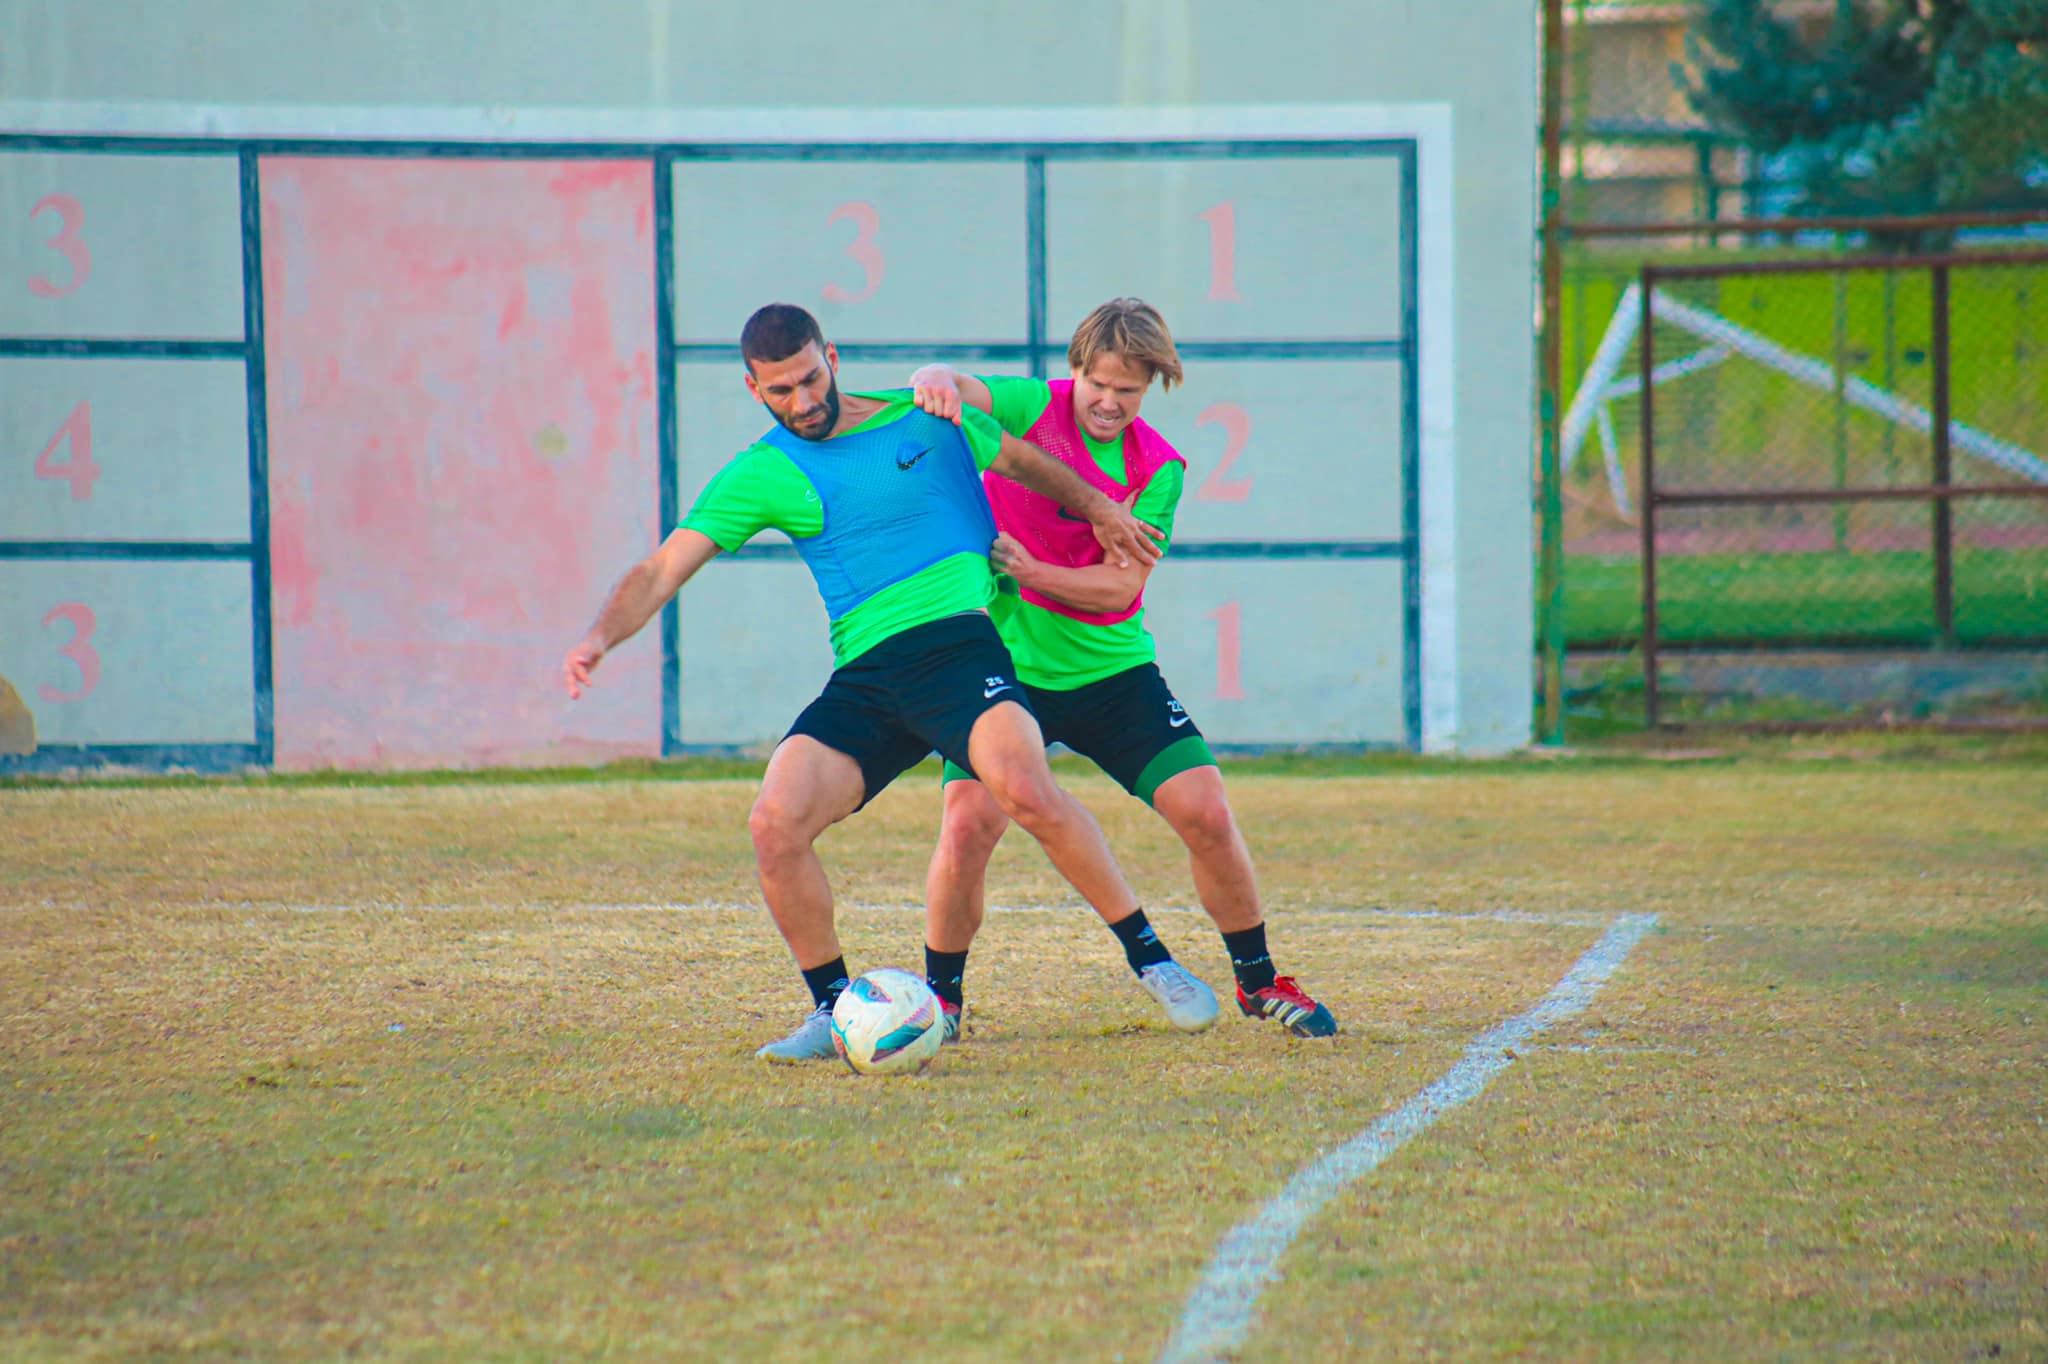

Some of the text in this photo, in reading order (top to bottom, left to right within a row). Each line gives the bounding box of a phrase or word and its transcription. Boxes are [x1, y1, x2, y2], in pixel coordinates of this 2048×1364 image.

[28, 193, 92, 298] 3
[822, 201, 885, 303] 3
[1200, 200, 1241, 301] 1
[34, 401, 101, 500] 4
[1196, 403, 1253, 502] 2
[39, 602, 102, 702] 3
[1206, 601, 1246, 700] 1
